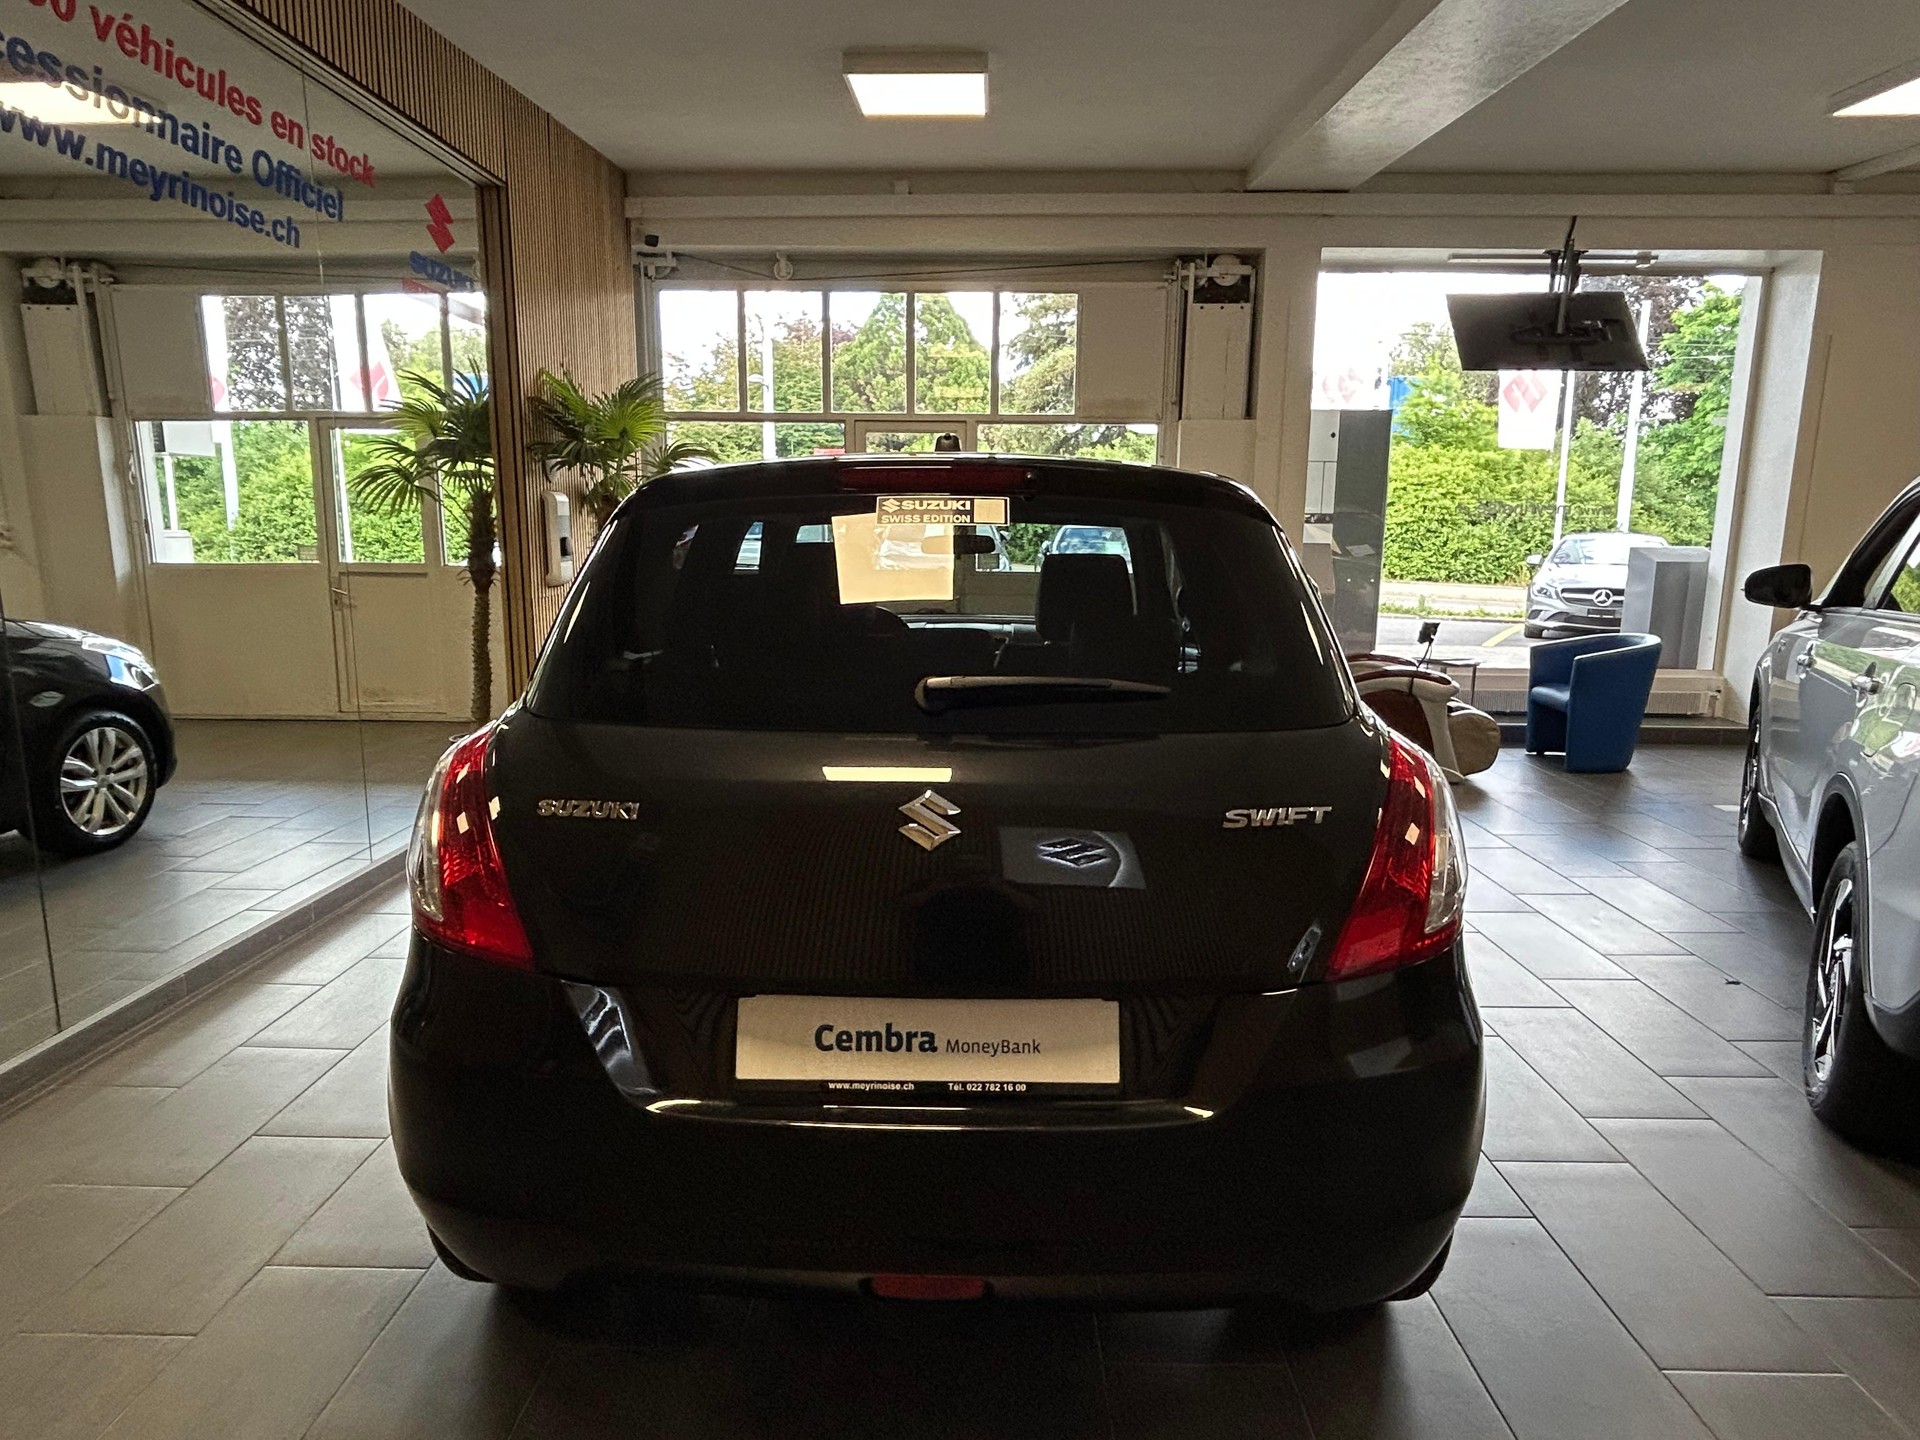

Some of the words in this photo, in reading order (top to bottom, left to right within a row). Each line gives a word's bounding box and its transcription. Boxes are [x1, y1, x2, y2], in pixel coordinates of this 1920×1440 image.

[89, 5, 262, 126] véhicules
[271, 111, 304, 150] en
[311, 133, 376, 189] stock
[0, 31, 243, 174] essionnaire
[252, 150, 344, 222] Officiel
[901, 499, 971, 511] SUZUKI
[881, 514, 921, 524] SWISS
[923, 514, 971, 524] EDITION
[536, 799, 640, 821] SUZUKI
[1222, 806, 1333, 829] SWIFT
[814, 1022, 938, 1054] Cembra
[945, 1038, 1041, 1056] MoneyBank
[828, 1081, 915, 1092] www.meyrinoise.ch
[966, 1083, 983, 1092] 022
[984, 1083, 1001, 1092] 782
[1003, 1083, 1014, 1092] 16
[1015, 1083, 1027, 1092] 00
